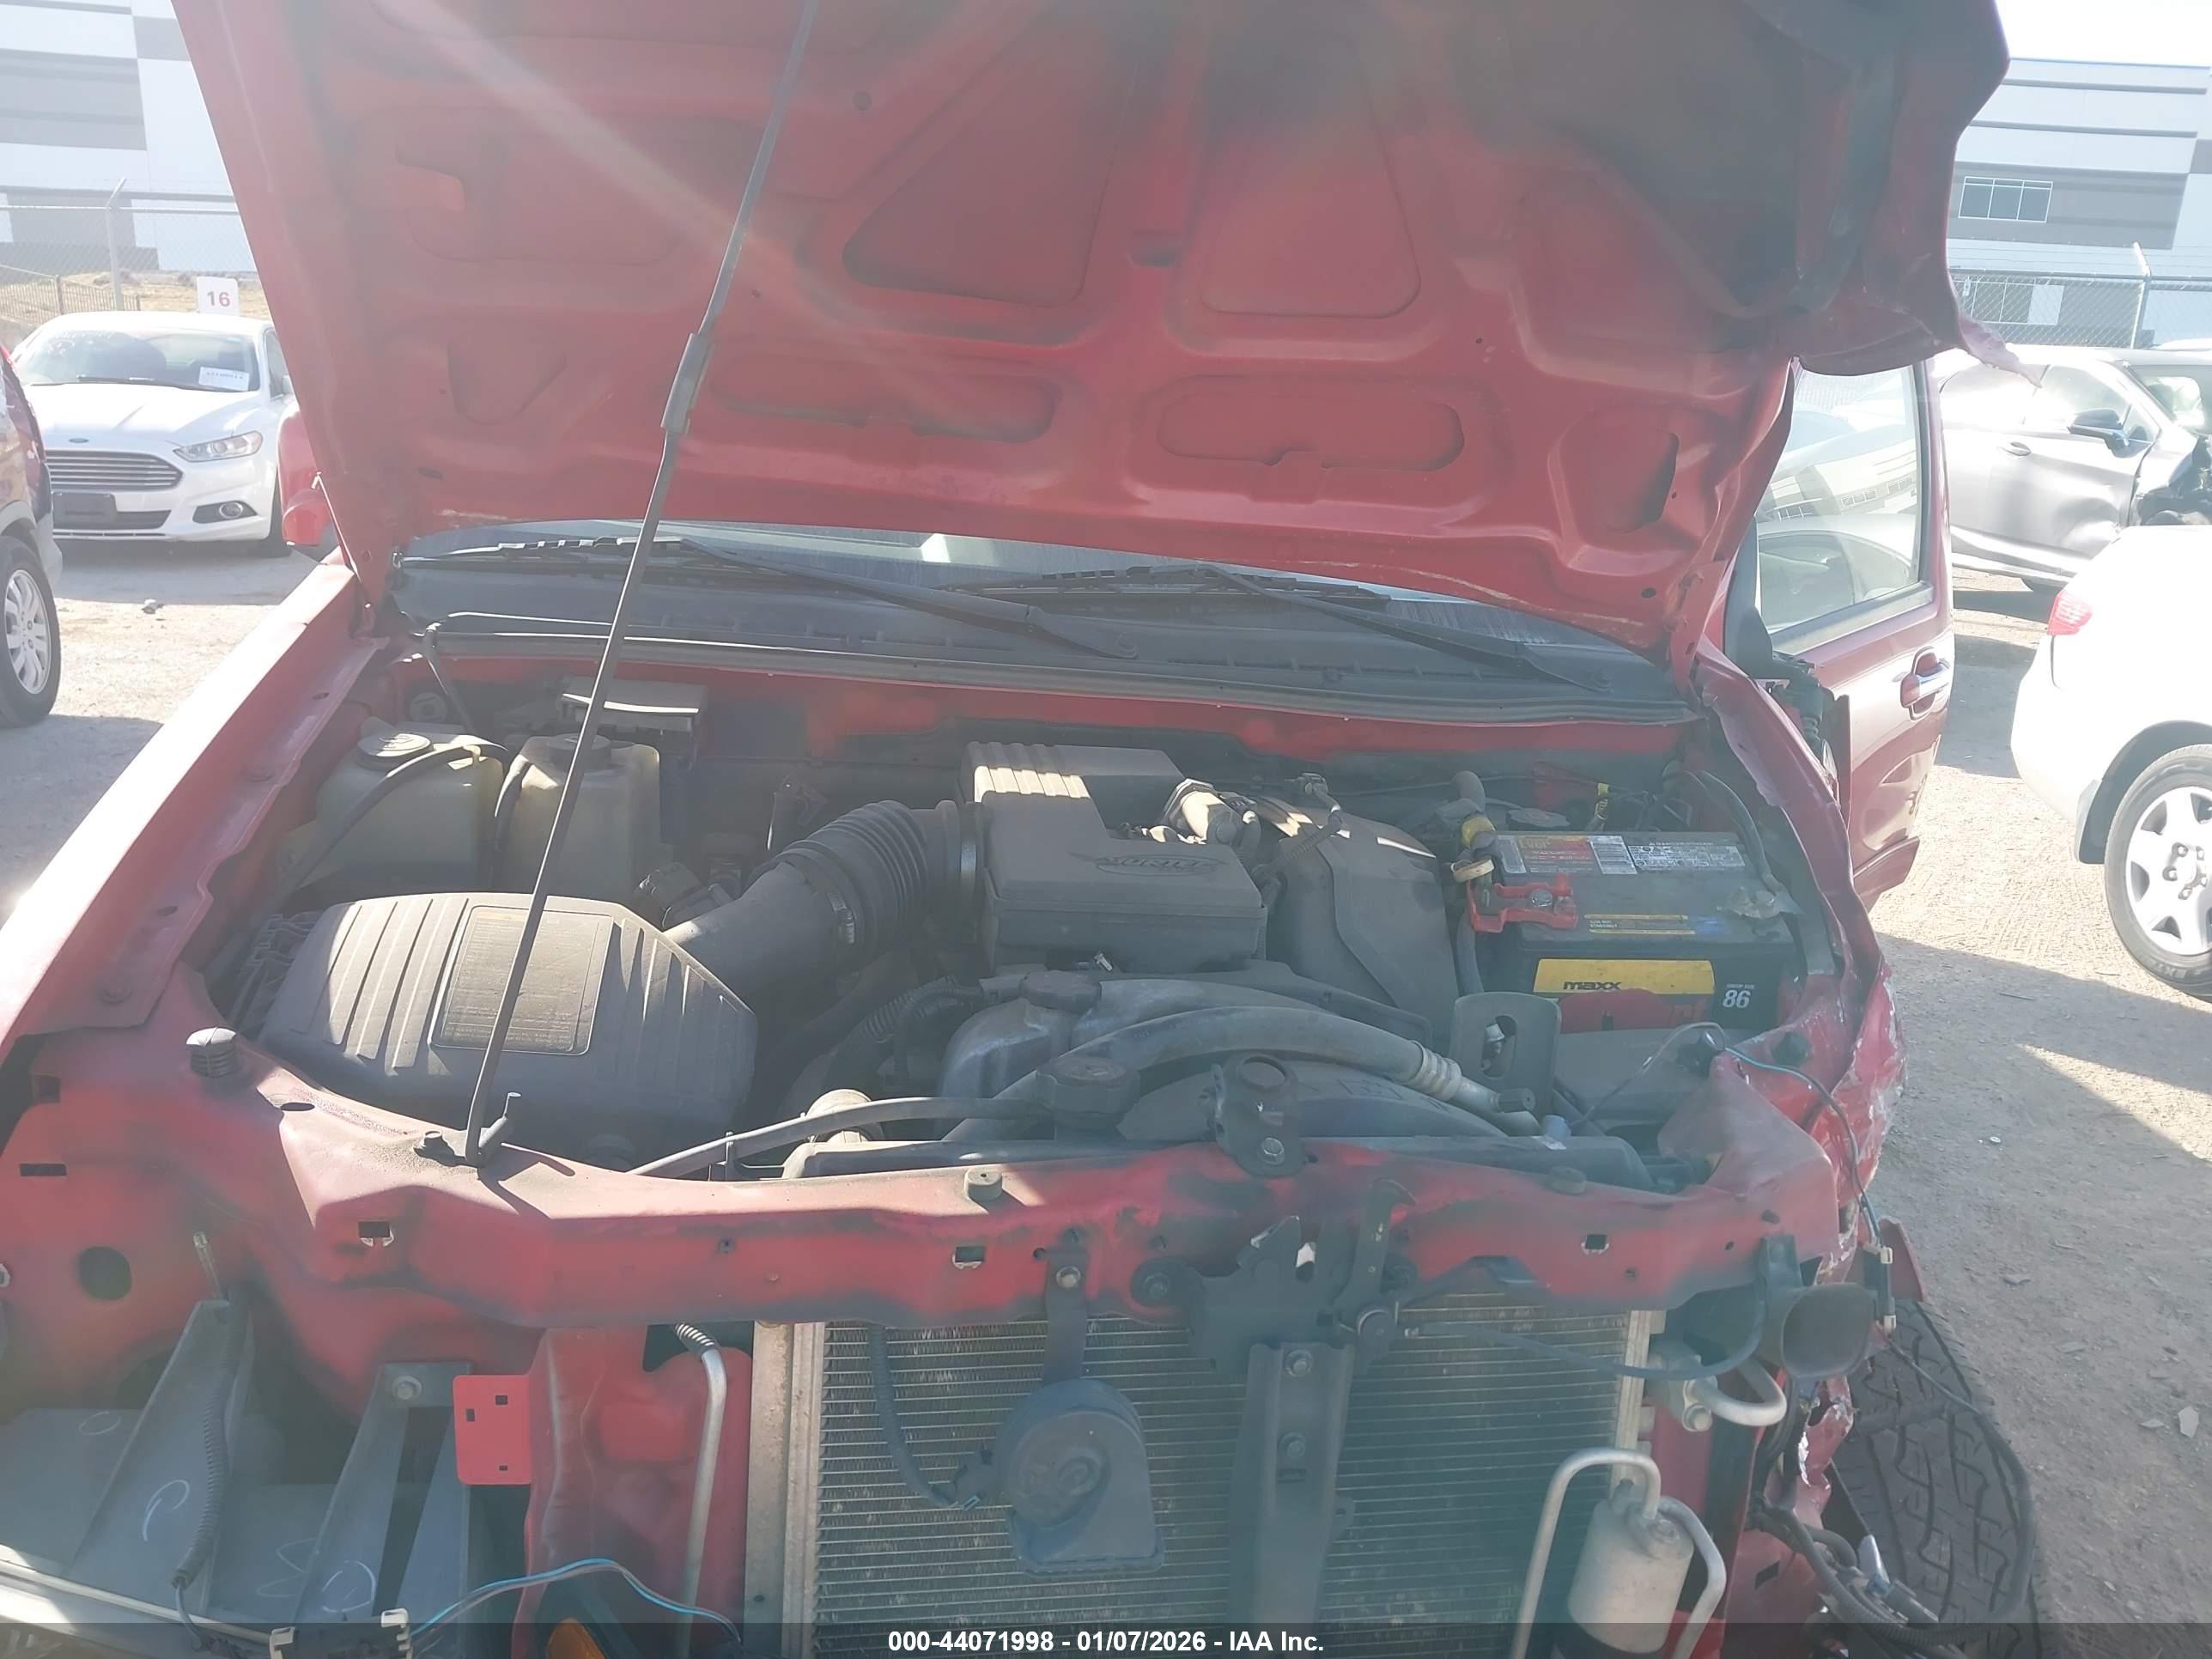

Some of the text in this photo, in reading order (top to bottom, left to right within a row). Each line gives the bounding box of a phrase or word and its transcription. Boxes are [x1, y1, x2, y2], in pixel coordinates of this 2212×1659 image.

[207, 290, 231, 307] 16
[1563, 981, 1621, 991] maxx
[1722, 989, 1751, 1009] 86
